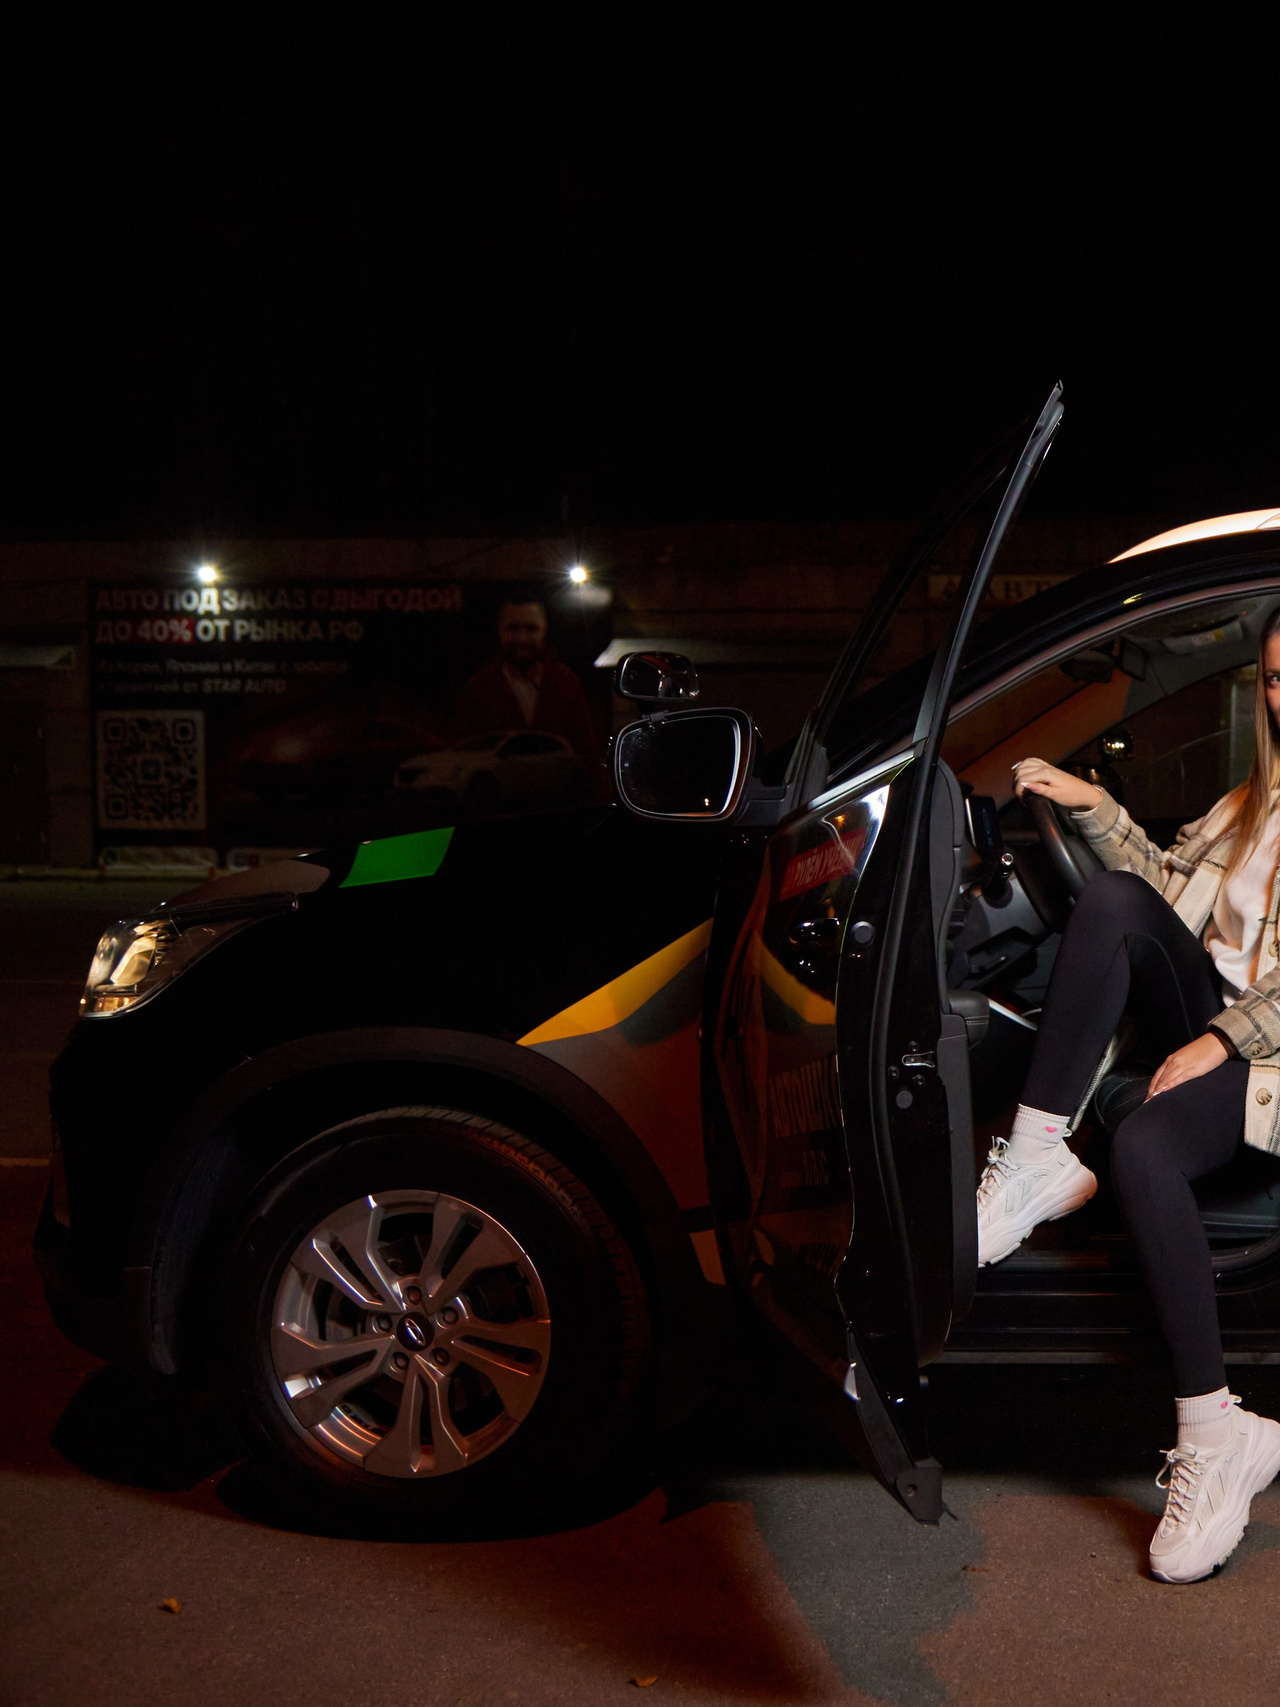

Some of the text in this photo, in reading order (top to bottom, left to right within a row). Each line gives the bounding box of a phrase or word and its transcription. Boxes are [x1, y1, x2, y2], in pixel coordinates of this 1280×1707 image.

[96, 588, 159, 612] АВТО
[163, 588, 221, 615] ПОД
[222, 588, 307, 612] ЗАКАЗ
[332, 584, 464, 614] ВЫГОДОЙ
[96, 618, 365, 645] ДО 40% ОТ РЫНКА РФ
